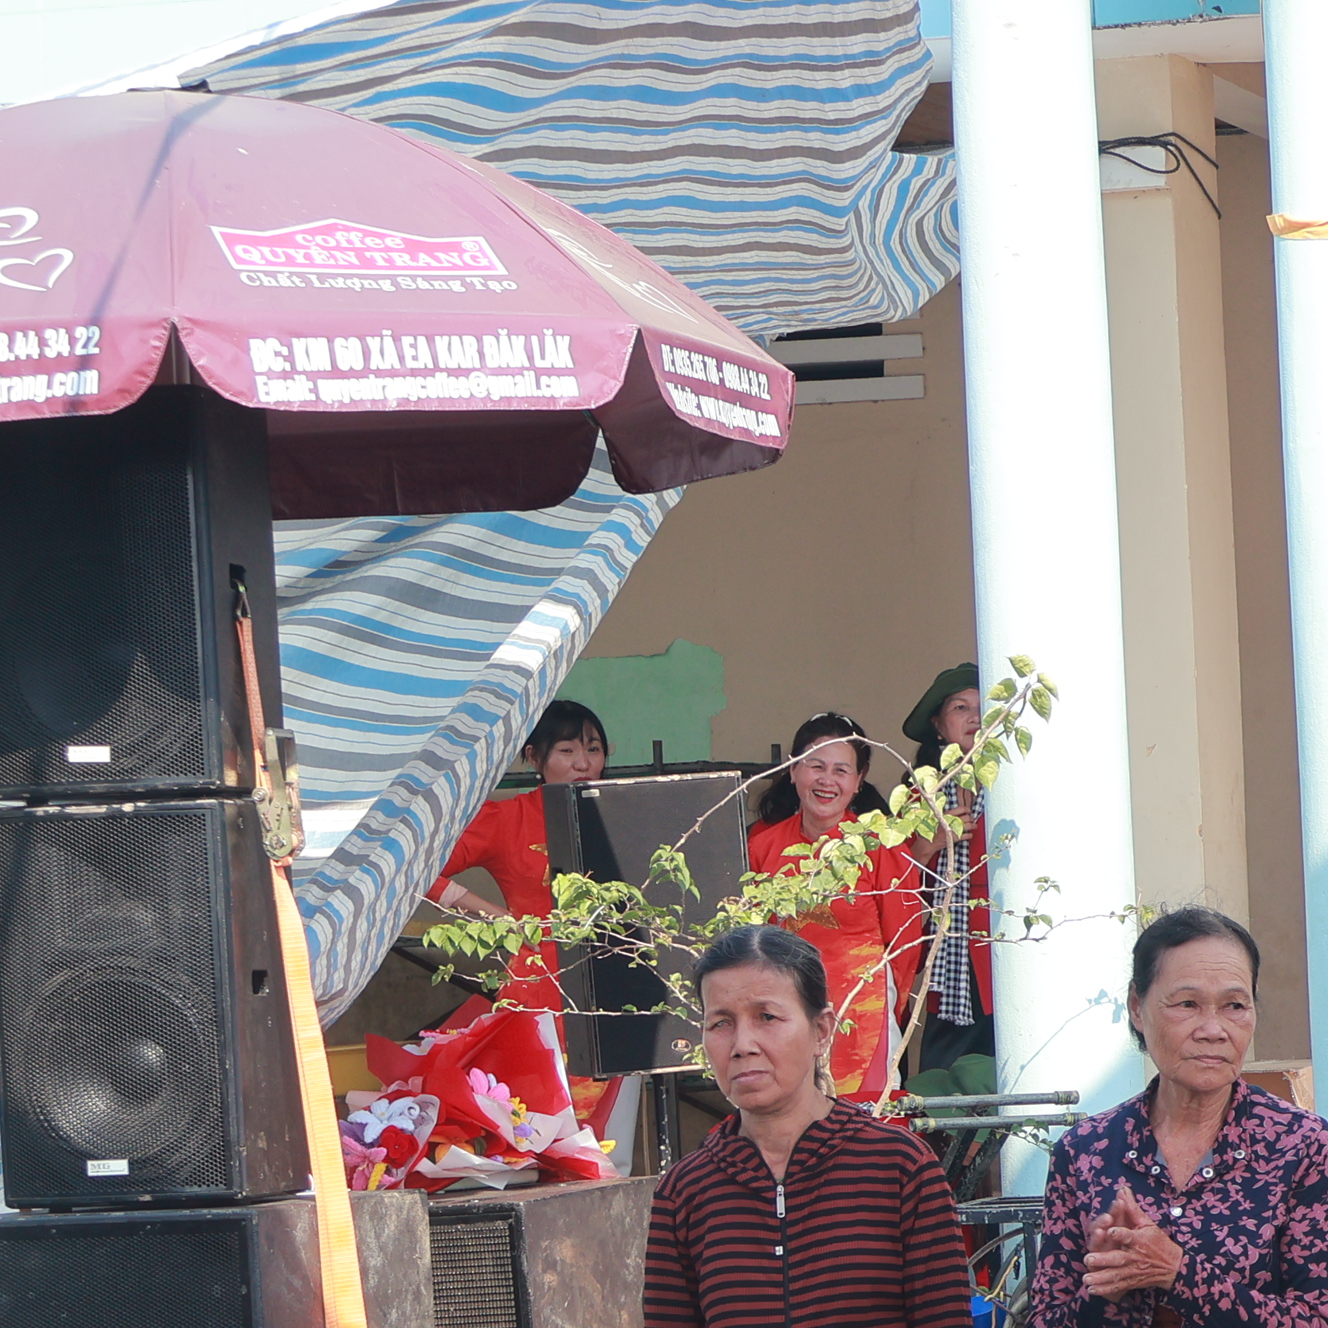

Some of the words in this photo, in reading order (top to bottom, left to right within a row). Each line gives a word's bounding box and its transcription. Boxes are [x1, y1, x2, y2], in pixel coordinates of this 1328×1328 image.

[367, 251, 491, 267] TRANG
[240, 272, 306, 288] Chất
[400, 276, 466, 292] Sáng
[467, 277, 518, 293] Tạo
[44, 328, 71, 358] 34
[74, 325, 101, 356] 22
[292, 337, 333, 371] KM
[334, 336, 365, 371] 60
[366, 329, 401, 370] XÃ
[401, 334, 434, 369] EA
[435, 335, 481, 369] KAR
[255, 375, 317, 402] Email:
